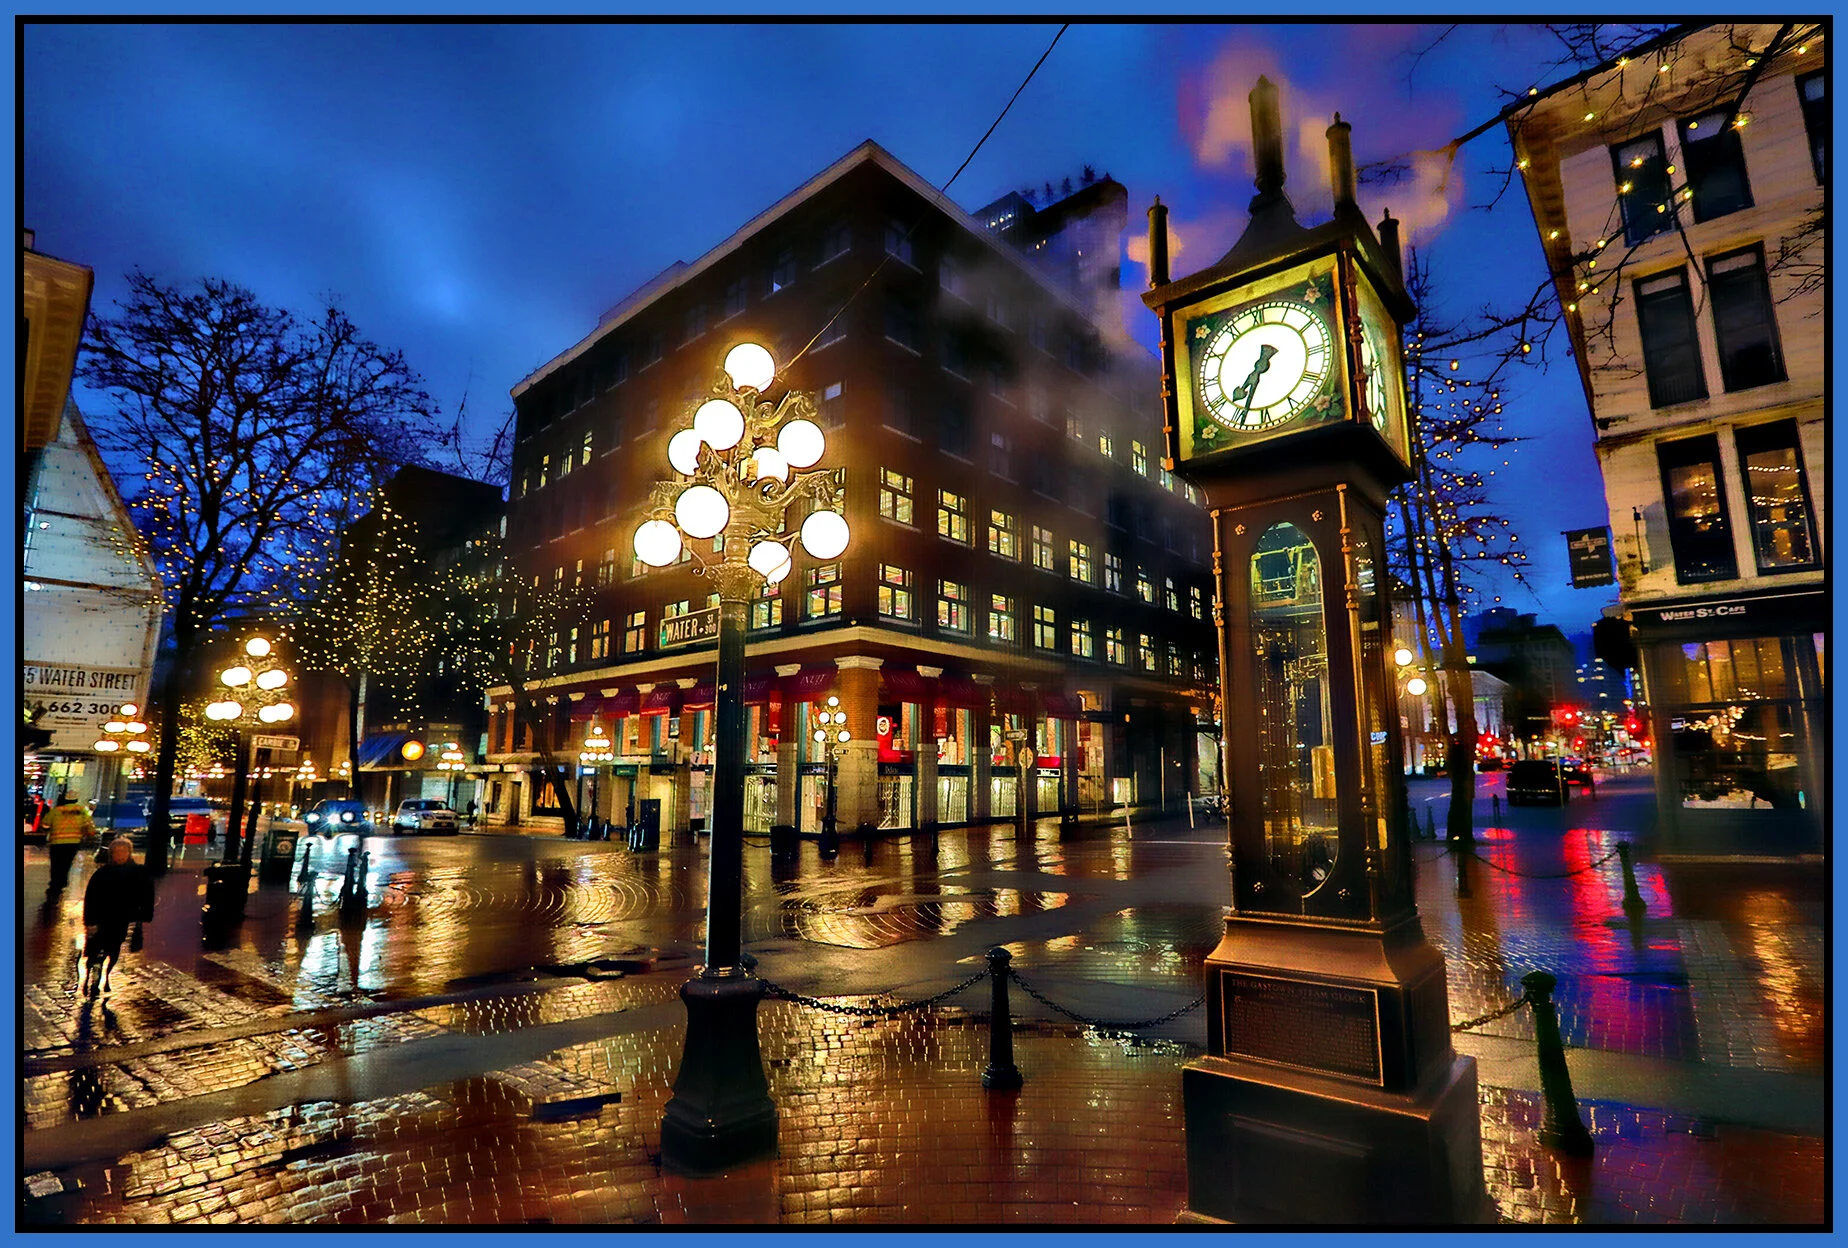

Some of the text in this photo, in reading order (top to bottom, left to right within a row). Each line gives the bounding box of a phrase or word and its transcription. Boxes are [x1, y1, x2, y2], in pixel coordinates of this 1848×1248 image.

[1660, 611, 1695, 621] WATER
[666, 614, 714, 642] WATER ST
[704, 623, 717, 635] 300
[40, 668, 86, 688] WATER
[89, 671, 137, 690] STREET
[48, 701, 83, 714] 662
[87, 703, 121, 714] 300
[1232, 979, 1367, 1004] THE GASTOWN STEAM CLOCK
